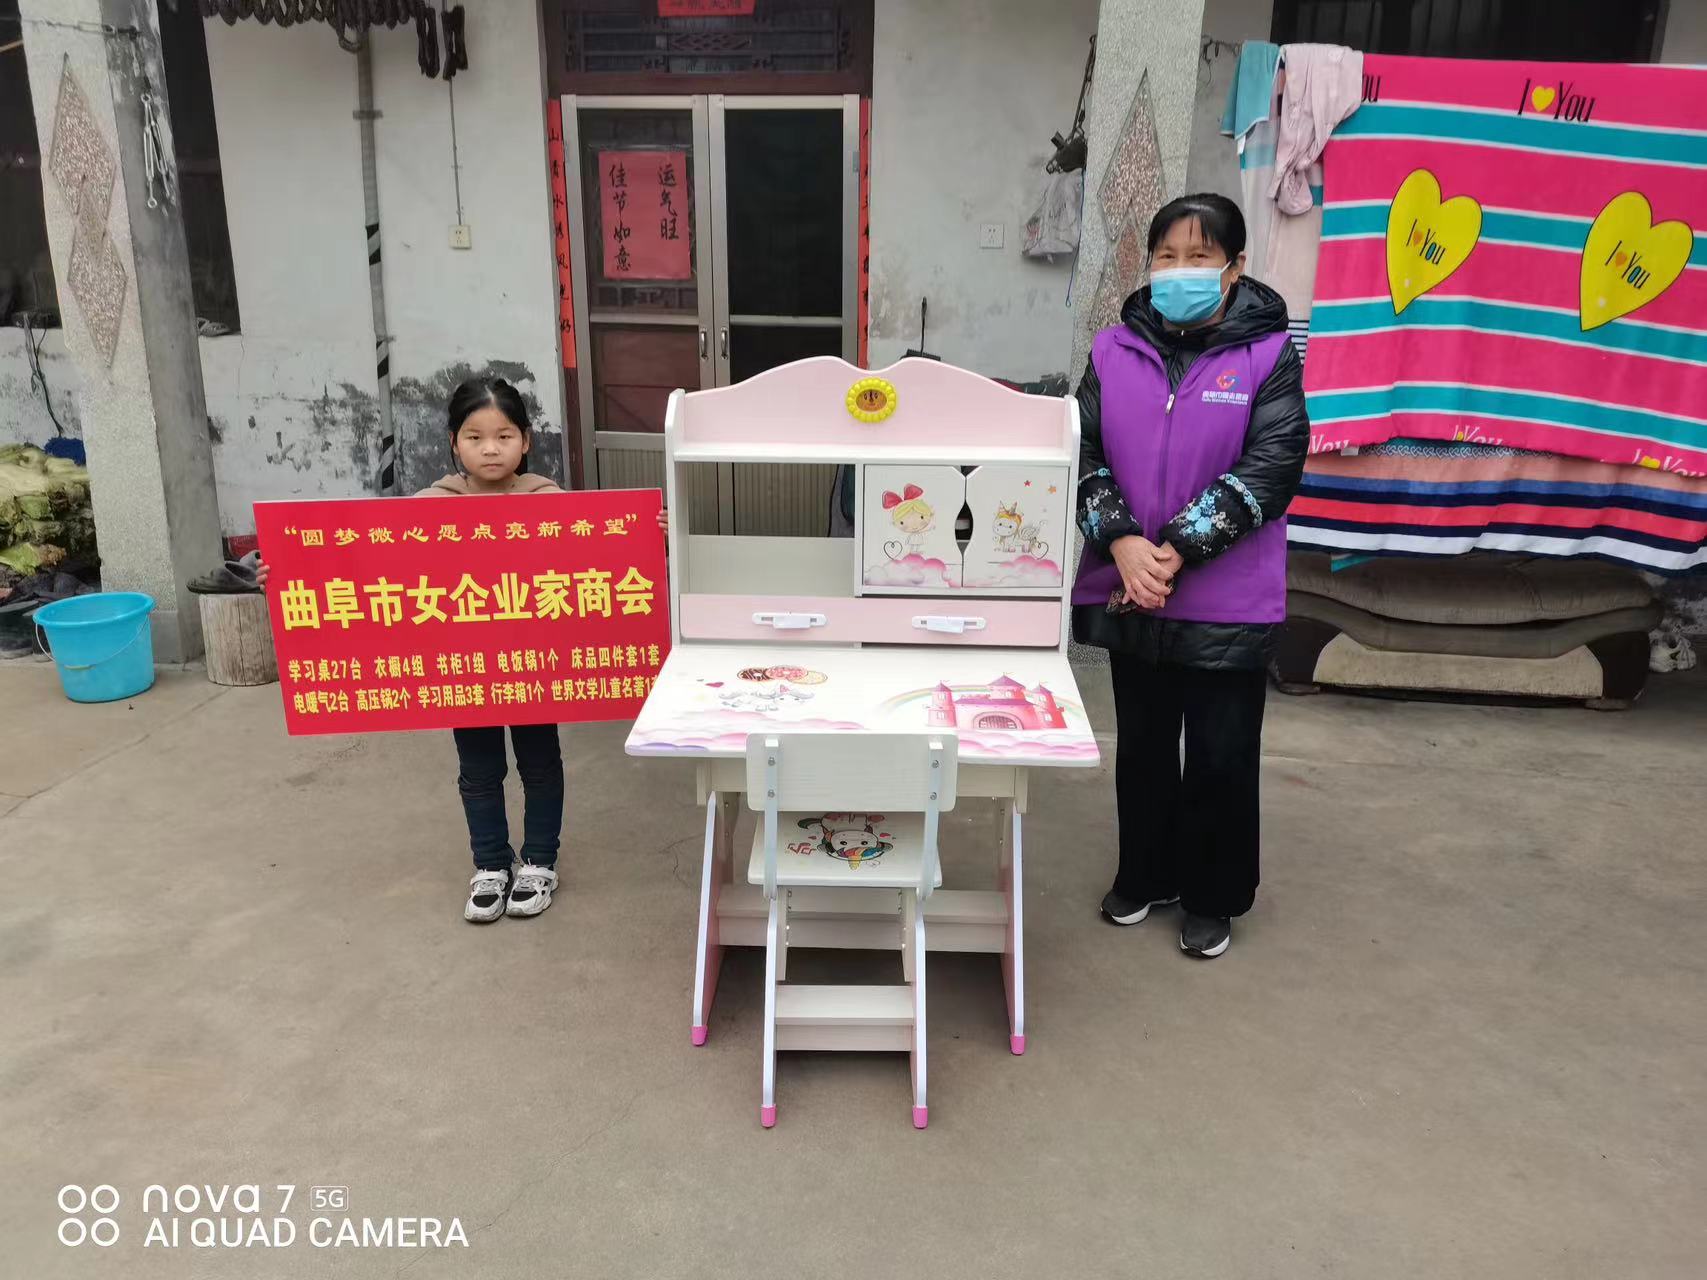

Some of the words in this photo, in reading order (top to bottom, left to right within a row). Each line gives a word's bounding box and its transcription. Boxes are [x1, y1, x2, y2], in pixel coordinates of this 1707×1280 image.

[1518, 78, 1531, 115] I
[1554, 81, 1596, 122] You
[609, 161, 631, 271] 佳节如意
[658, 163, 679, 240] 运气旺
[1419, 228, 1446, 264] You
[1621, 251, 1651, 289] You
[279, 566, 655, 631] 曲阜市女企业家商会
[288, 657, 362, 683] 学习桌27台
[374, 655, 425, 679] 衣橱4组
[436, 652, 486, 675] 书柜1组
[497, 648, 559, 673] 电饭锅1个
[571, 643, 660, 669] 床品四件套1套
[293, 689, 349, 714] 电暖气2台
[355, 687, 411, 711] 高压锅2个
[417, 683, 485, 708] 学习用品3套
[491, 680, 545, 705] 行李箱1个
